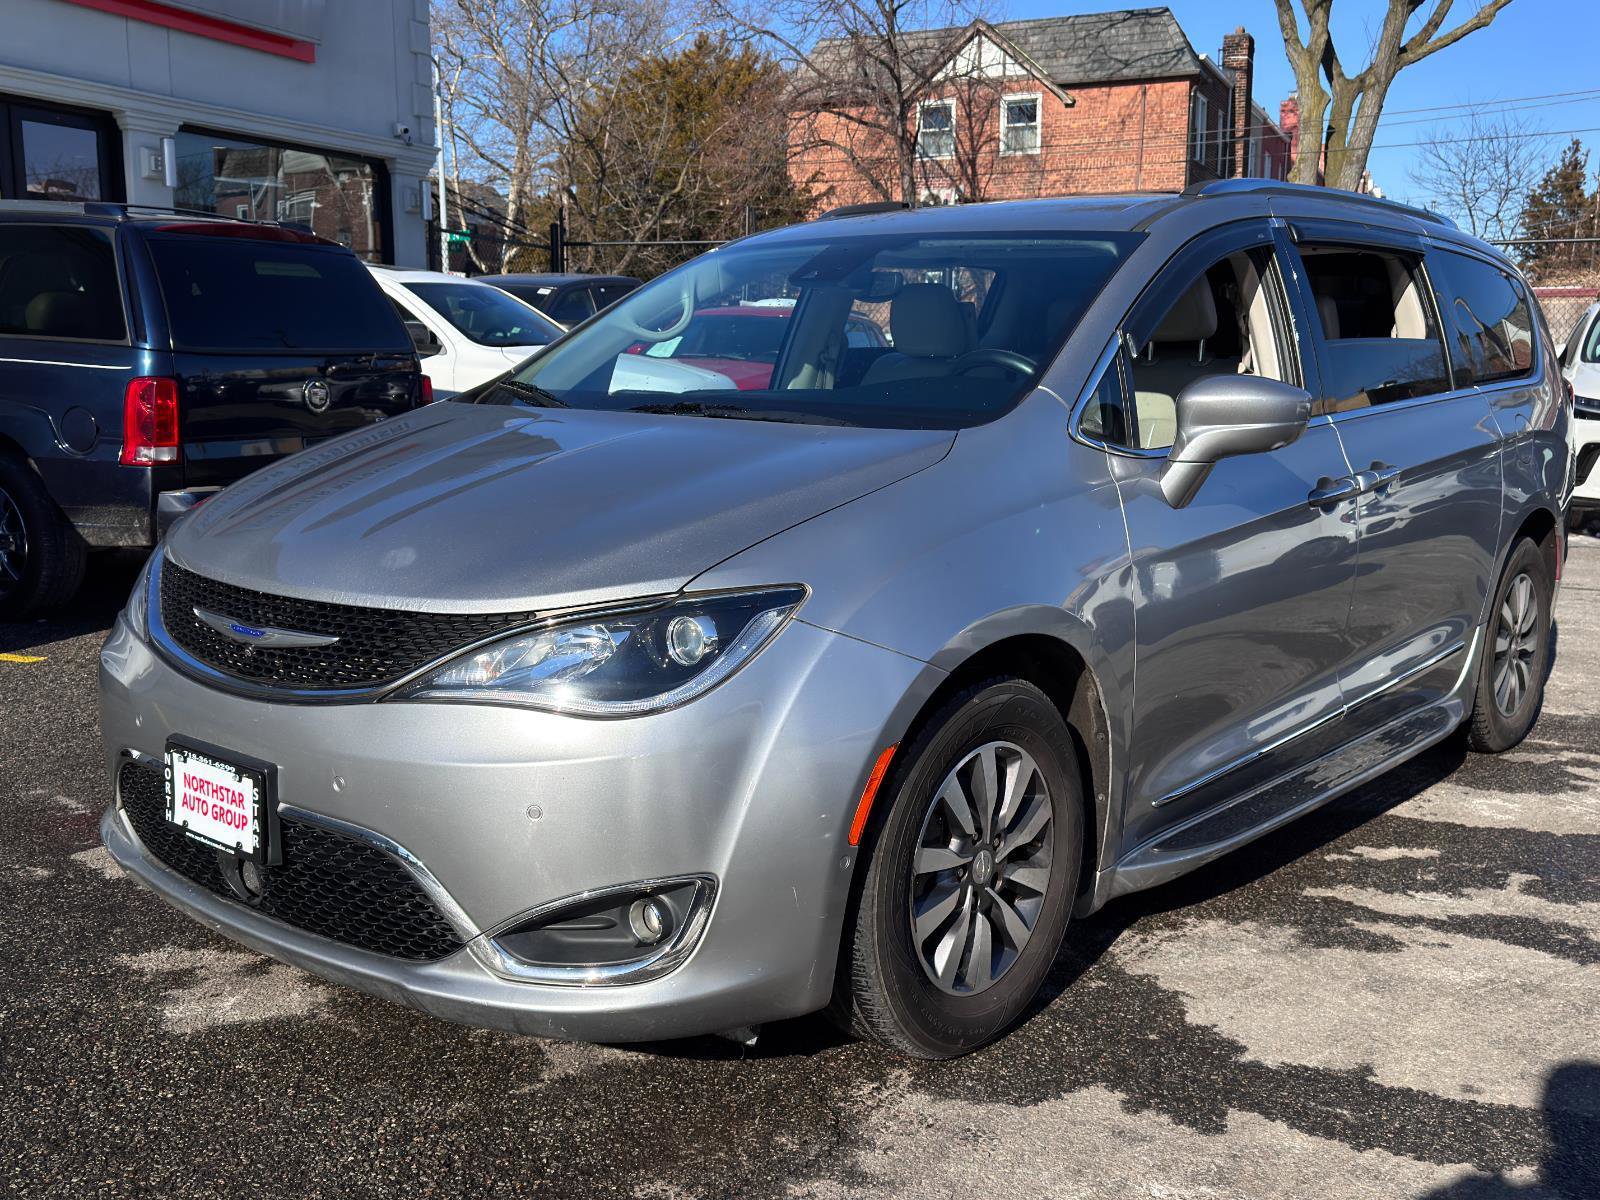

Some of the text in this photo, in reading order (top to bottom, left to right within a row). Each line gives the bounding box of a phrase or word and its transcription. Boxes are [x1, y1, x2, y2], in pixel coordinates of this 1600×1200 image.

[164, 752, 172, 822] NORTH
[181, 792, 248, 831] AUTO GROUP
[183, 772, 245, 810] NORTHSTAR
[252, 788, 260, 848] STAR
